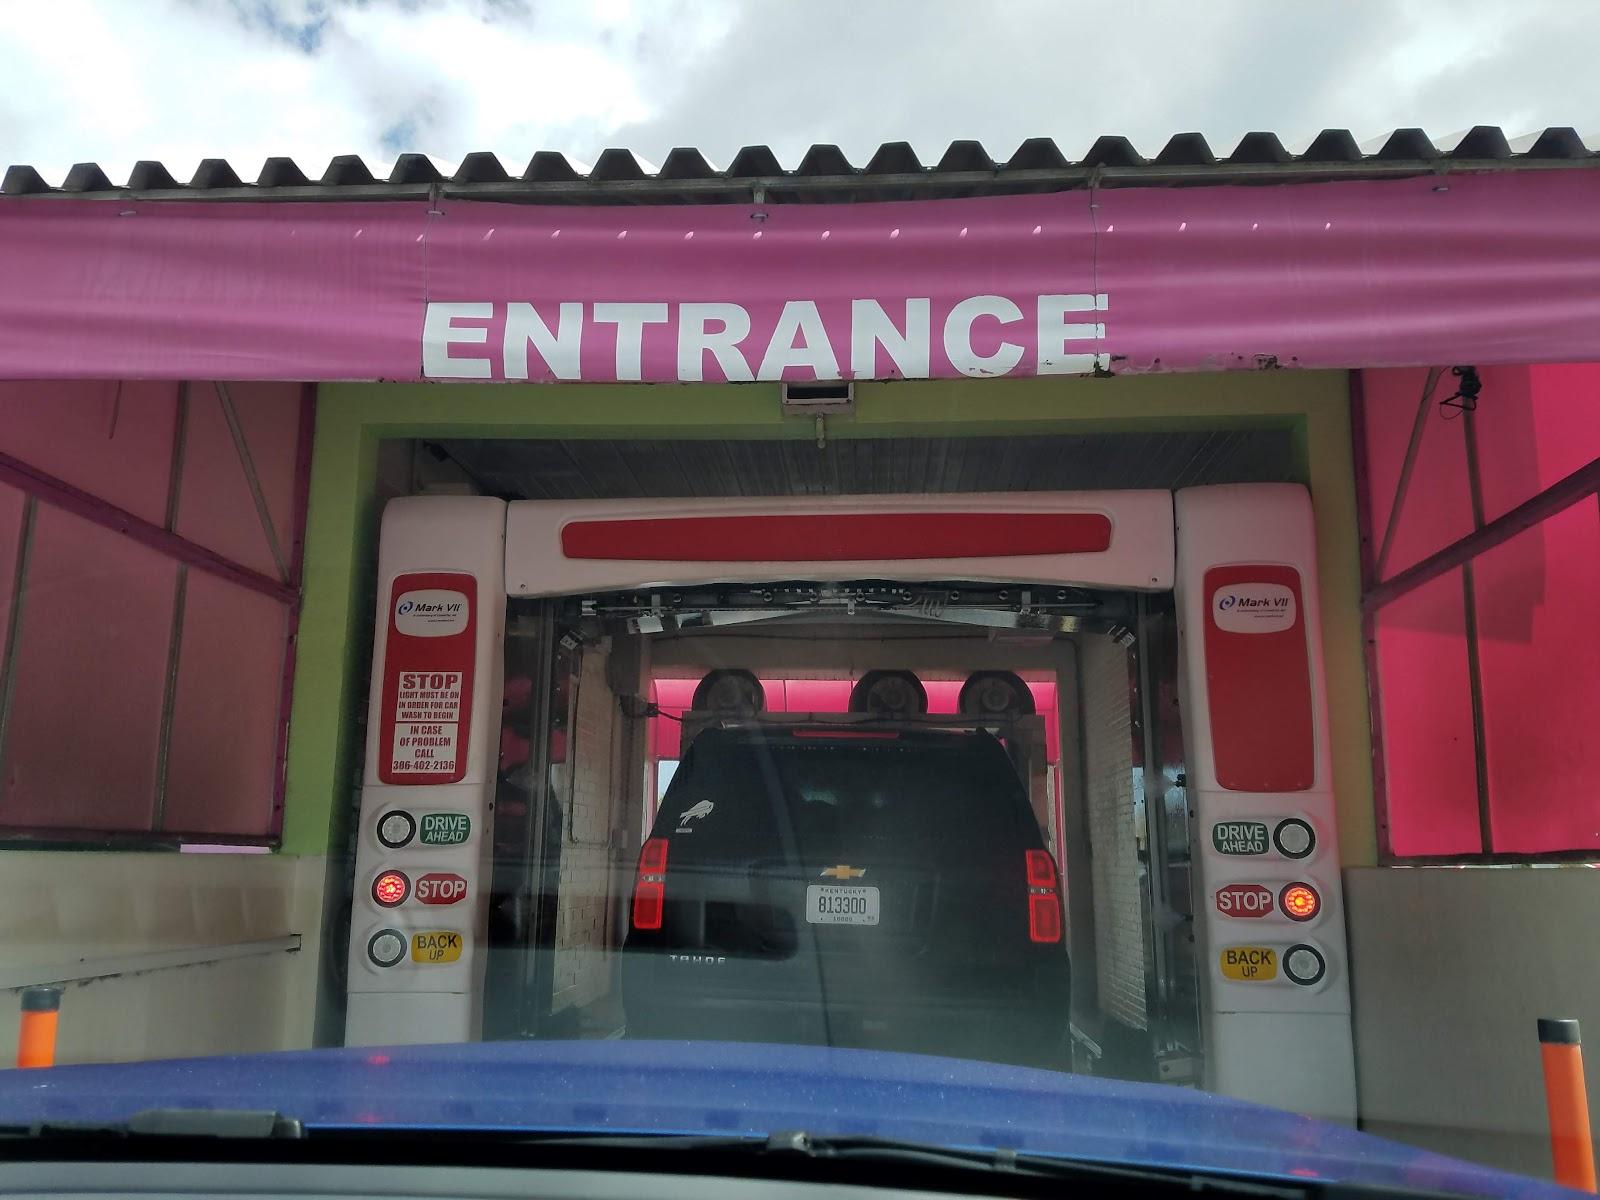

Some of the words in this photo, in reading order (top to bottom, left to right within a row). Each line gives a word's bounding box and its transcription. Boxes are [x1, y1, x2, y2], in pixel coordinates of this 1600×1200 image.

[422, 293, 1110, 382] ENTRANCE
[415, 603, 444, 613] Mark
[1238, 598, 1270, 607] Mark
[402, 673, 458, 690] STOP
[399, 691, 419, 699] LIGHT
[420, 691, 440, 699] MUST
[440, 691, 450, 699] BE
[450, 691, 460, 699] ON
[398, 701, 407, 709] IN
[407, 701, 430, 709] ORDER
[430, 701, 443, 709] FOR
[444, 701, 459, 709] CAR
[401, 711, 422, 719] WASH
[423, 711, 433, 719] TO
[433, 711, 454, 719] BEGIN
[410, 725, 420, 735] IN
[421, 725, 443, 735] CASE
[399, 737, 411, 747] OF
[412, 737, 451, 747] PROBLEM
[414, 748, 435, 758] CALL
[424, 816, 467, 831] DRIVE
[425, 831, 463, 842] AHEAD
[1216, 825, 1265, 840] DRIVE
[1222, 840, 1263, 852] AHEAD
[417, 880, 466, 898] STOP
[818, 896, 867, 914] 813300
[1219, 891, 1273, 910] STOP
[417, 934, 458, 949] BACK
[429, 950, 444, 961] UP
[1226, 950, 1271, 966] BACK
[1242, 966, 1258, 977] UP
